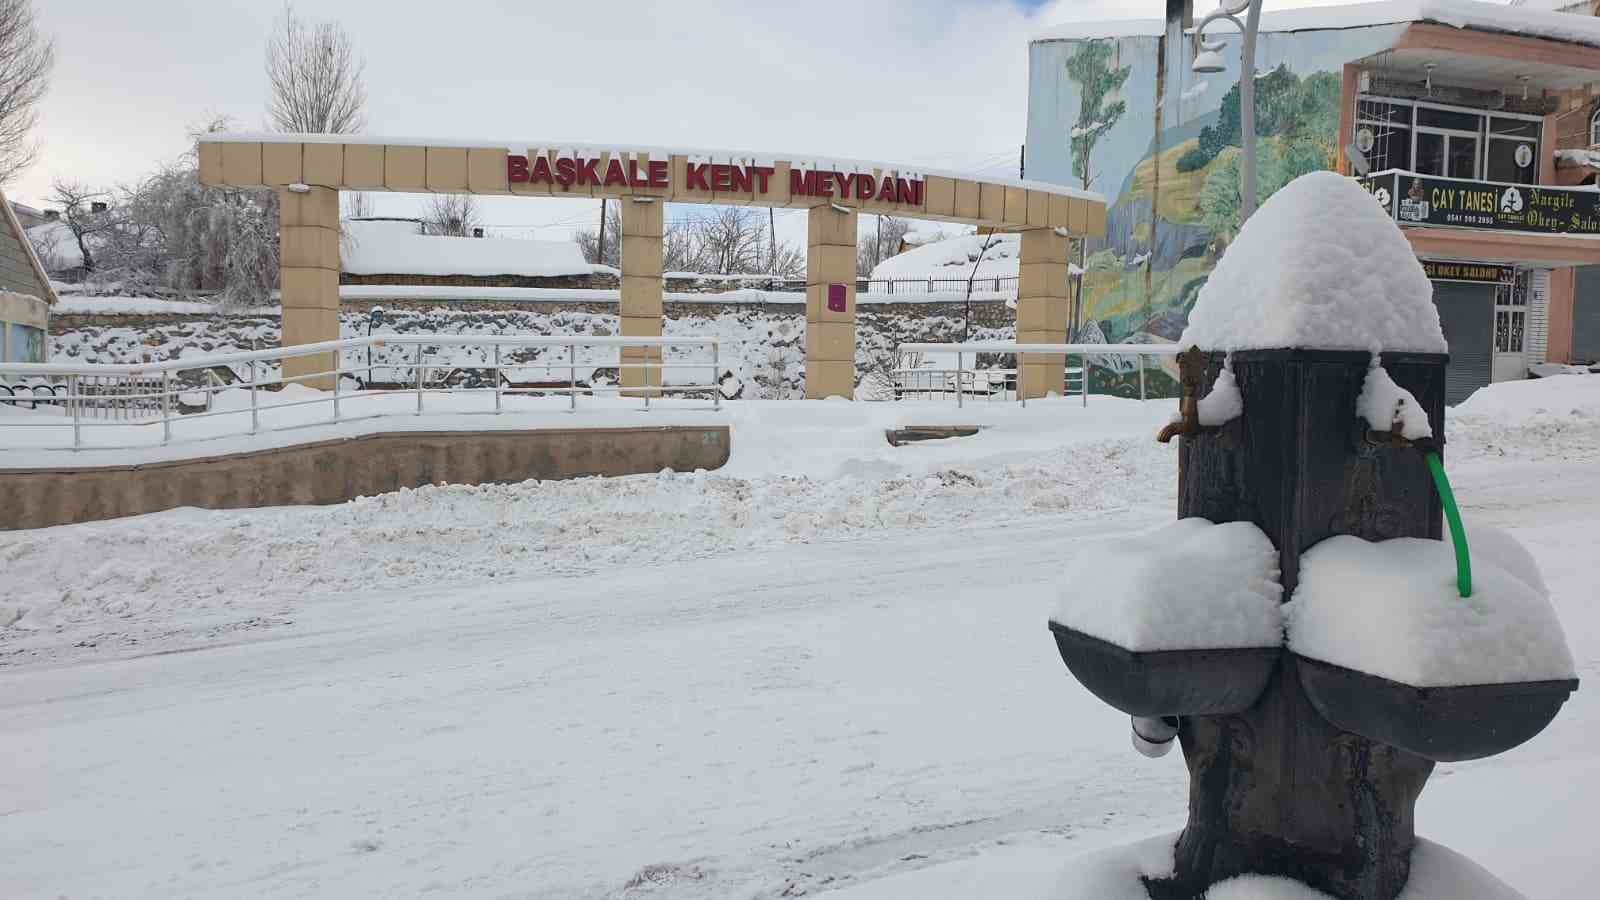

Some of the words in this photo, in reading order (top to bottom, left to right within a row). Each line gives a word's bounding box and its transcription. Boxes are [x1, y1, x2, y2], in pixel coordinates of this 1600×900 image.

[507, 154, 668, 191] BAŞKALE
[687, 161, 775, 194] KENT
[790, 168, 924, 205] MEYDANI
[1432, 187, 1455, 211] ÇAY
[1459, 187, 1498, 213] TANESİ
[1529, 188, 1574, 211] Nargile
[1568, 212, 1600, 232] Salo
